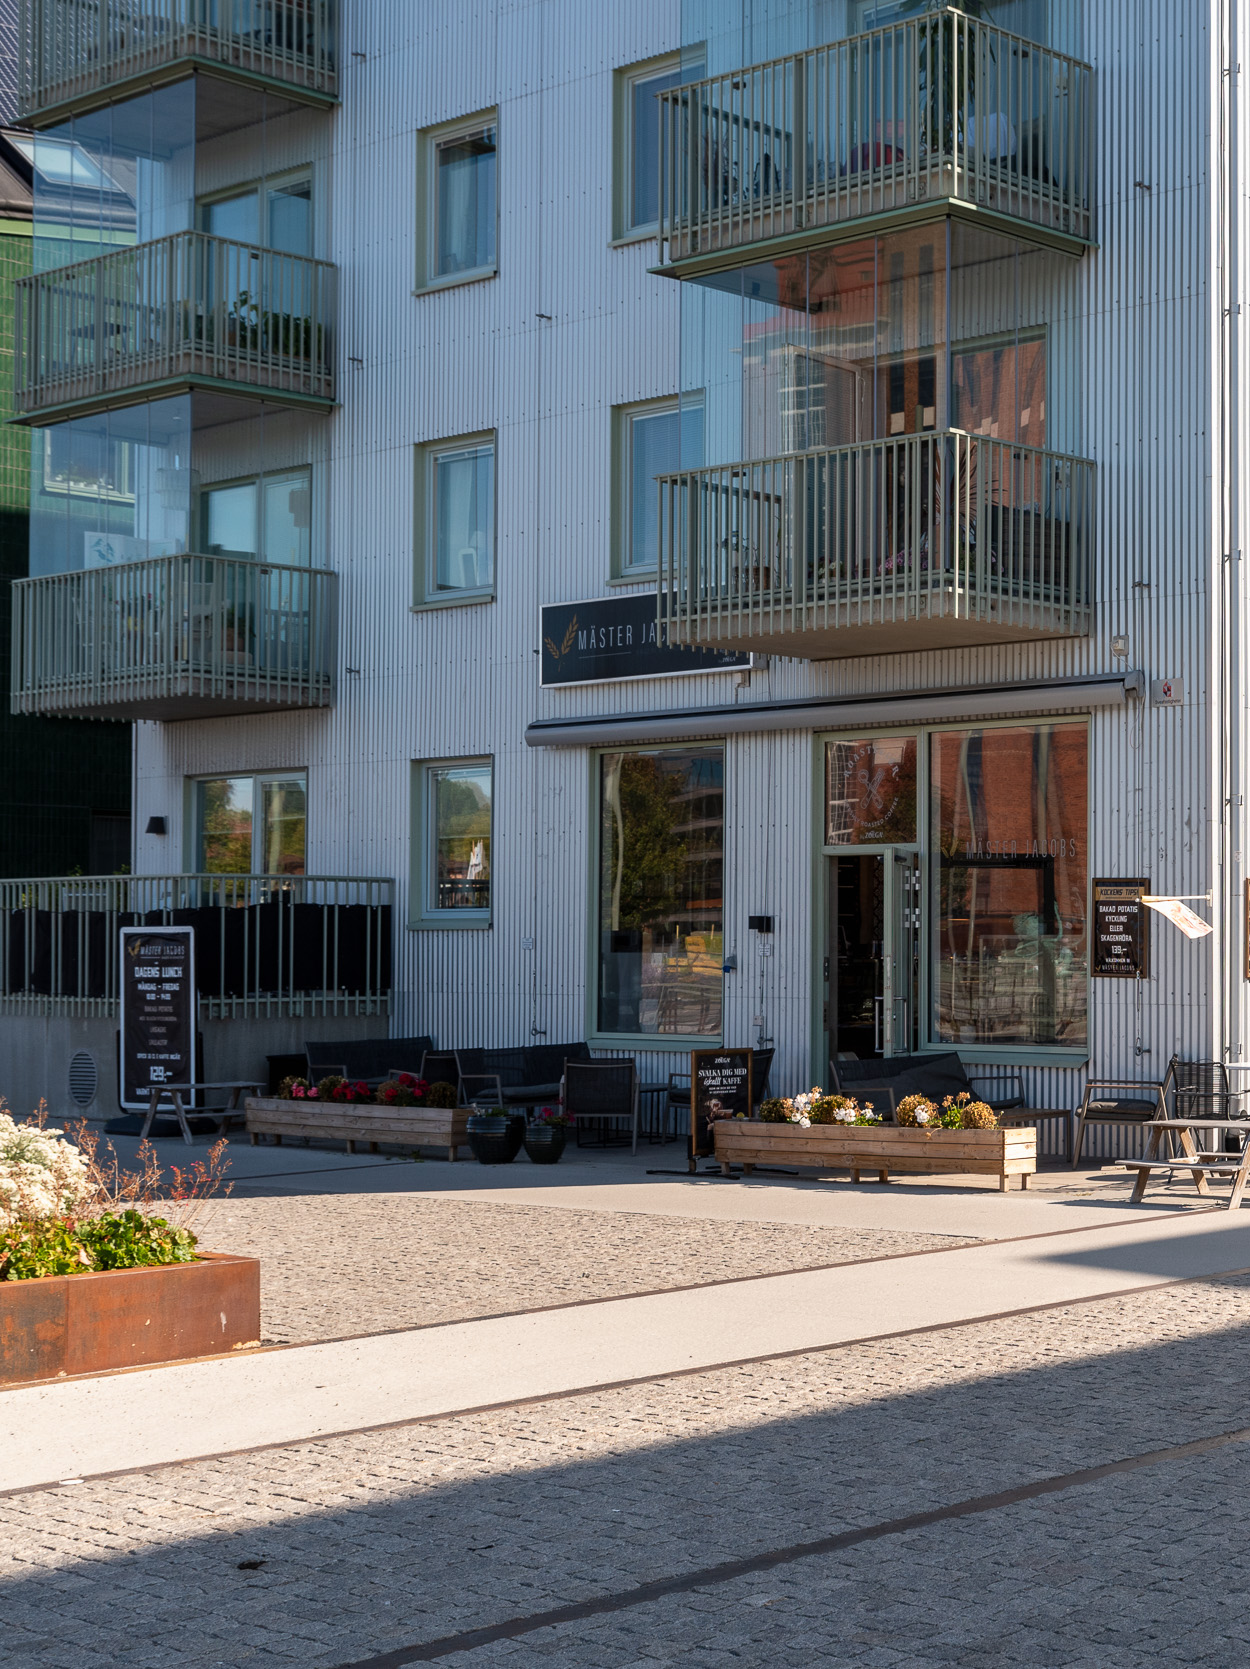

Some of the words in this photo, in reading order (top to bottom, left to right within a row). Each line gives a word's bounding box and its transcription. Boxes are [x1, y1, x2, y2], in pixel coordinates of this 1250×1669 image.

[578, 625, 633, 650] MÄSTER
[966, 838, 1017, 859] MÄSTER
[1025, 838, 1076, 859] JACOBS
[1100, 888, 1123, 896] KOCKENS
[1117, 905, 1138, 913] POTATIS
[1105, 915, 1128, 923] KYCKLING
[1100, 934, 1133, 942] SKAGENRÖRA
[140, 945, 161, 955] MÄSTER
[163, 945, 185, 955] JACOBS
[134, 966, 160, 978] DAGENS
[162, 966, 183, 978] LUNCH
[137, 981, 157, 991] MÅNDAG
[162, 982, 180, 991] FREDAG
[698, 1069, 721, 1078] SVALKA
[733, 1067, 747, 1076] MED
[722, 1076, 742, 1085] KAFFE
